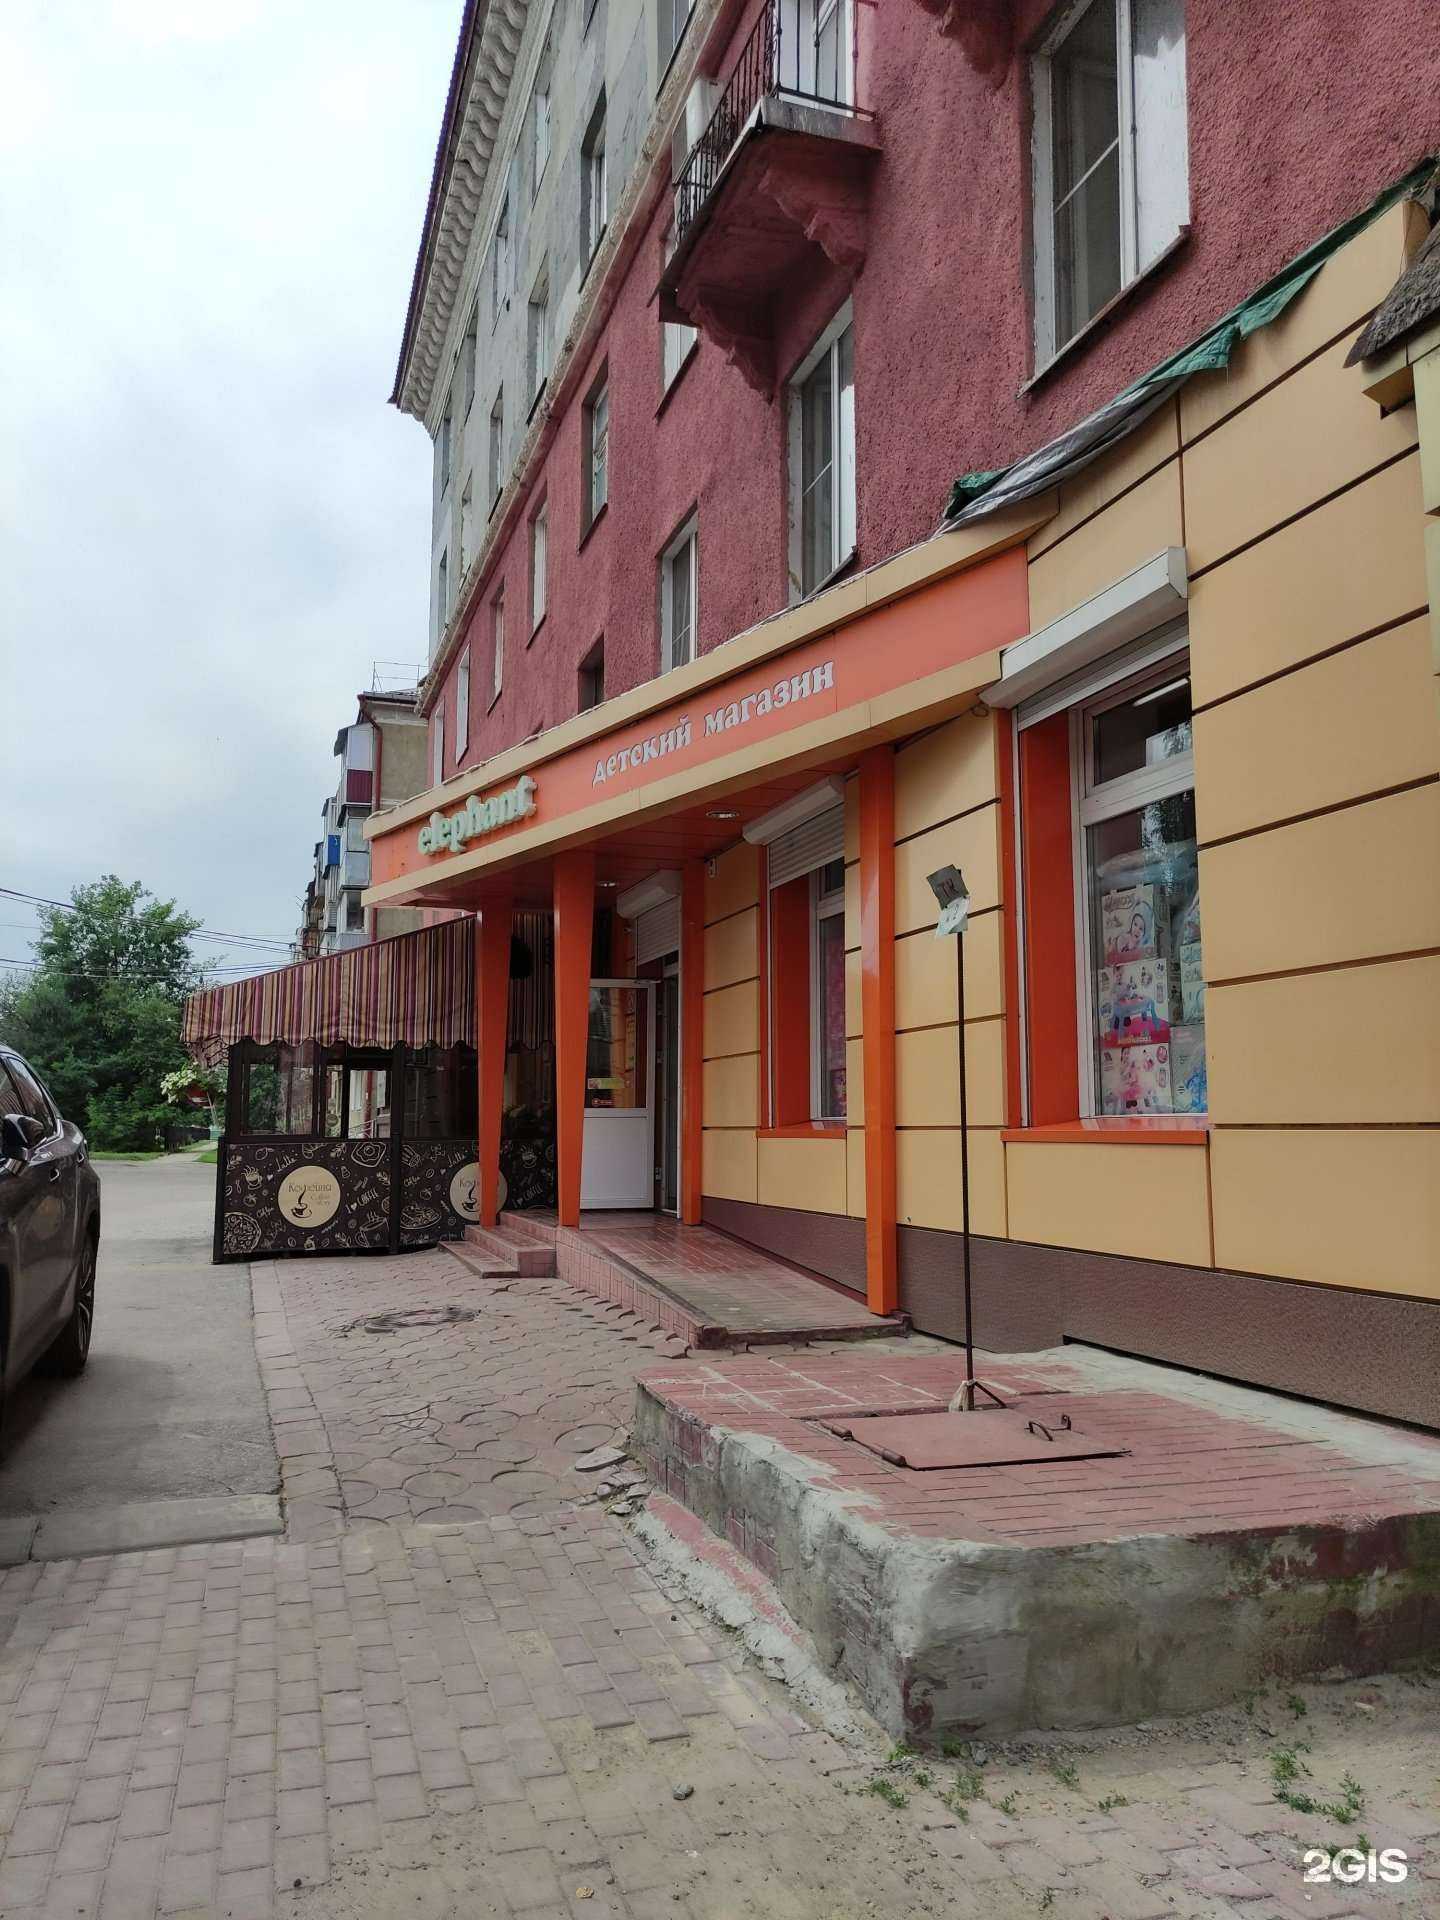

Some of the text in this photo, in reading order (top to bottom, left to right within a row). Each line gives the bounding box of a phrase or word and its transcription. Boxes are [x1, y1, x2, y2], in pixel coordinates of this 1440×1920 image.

[592, 660, 835, 788] детский магазин
[418, 775, 537, 855] elephant
